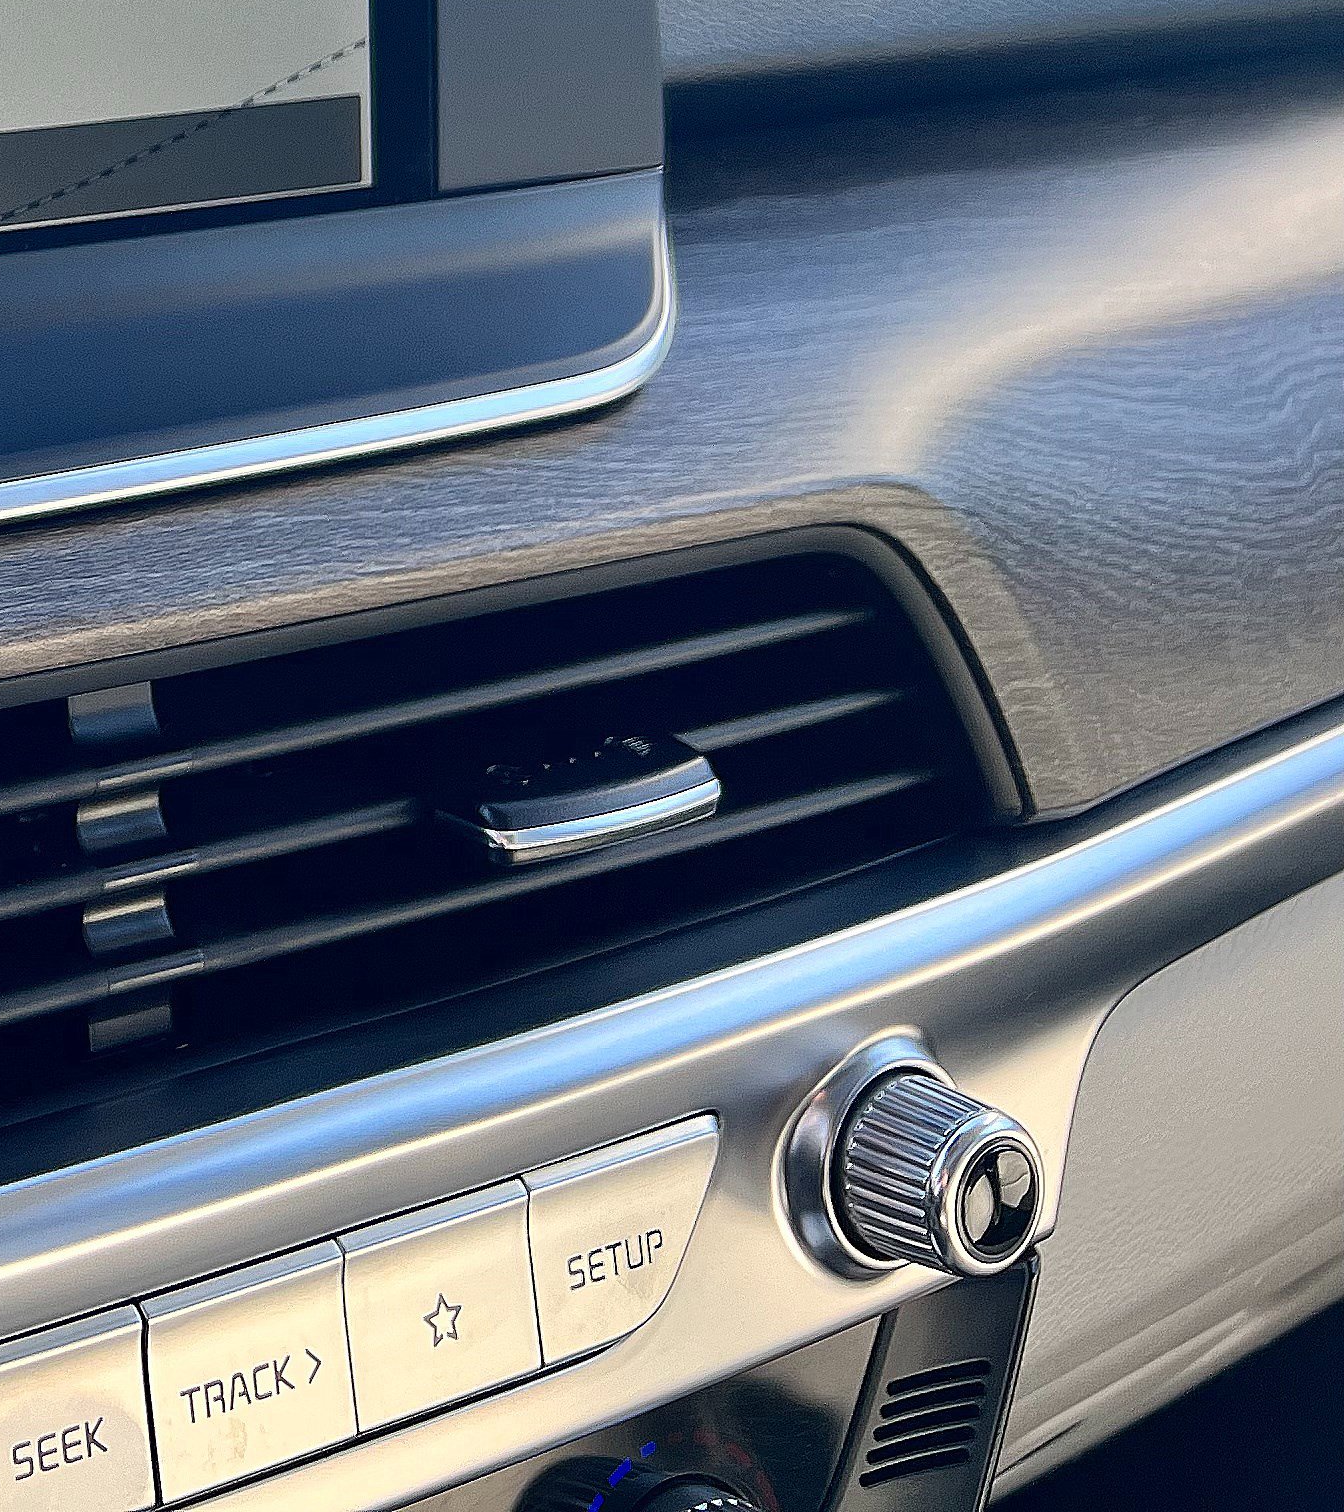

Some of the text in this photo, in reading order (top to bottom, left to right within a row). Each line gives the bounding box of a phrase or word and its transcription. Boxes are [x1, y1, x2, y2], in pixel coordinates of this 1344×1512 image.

[567, 1229, 666, 1290] SETUP
[180, 1358, 294, 1424] TRACK
[12, 1416, 109, 1482] SEEK
